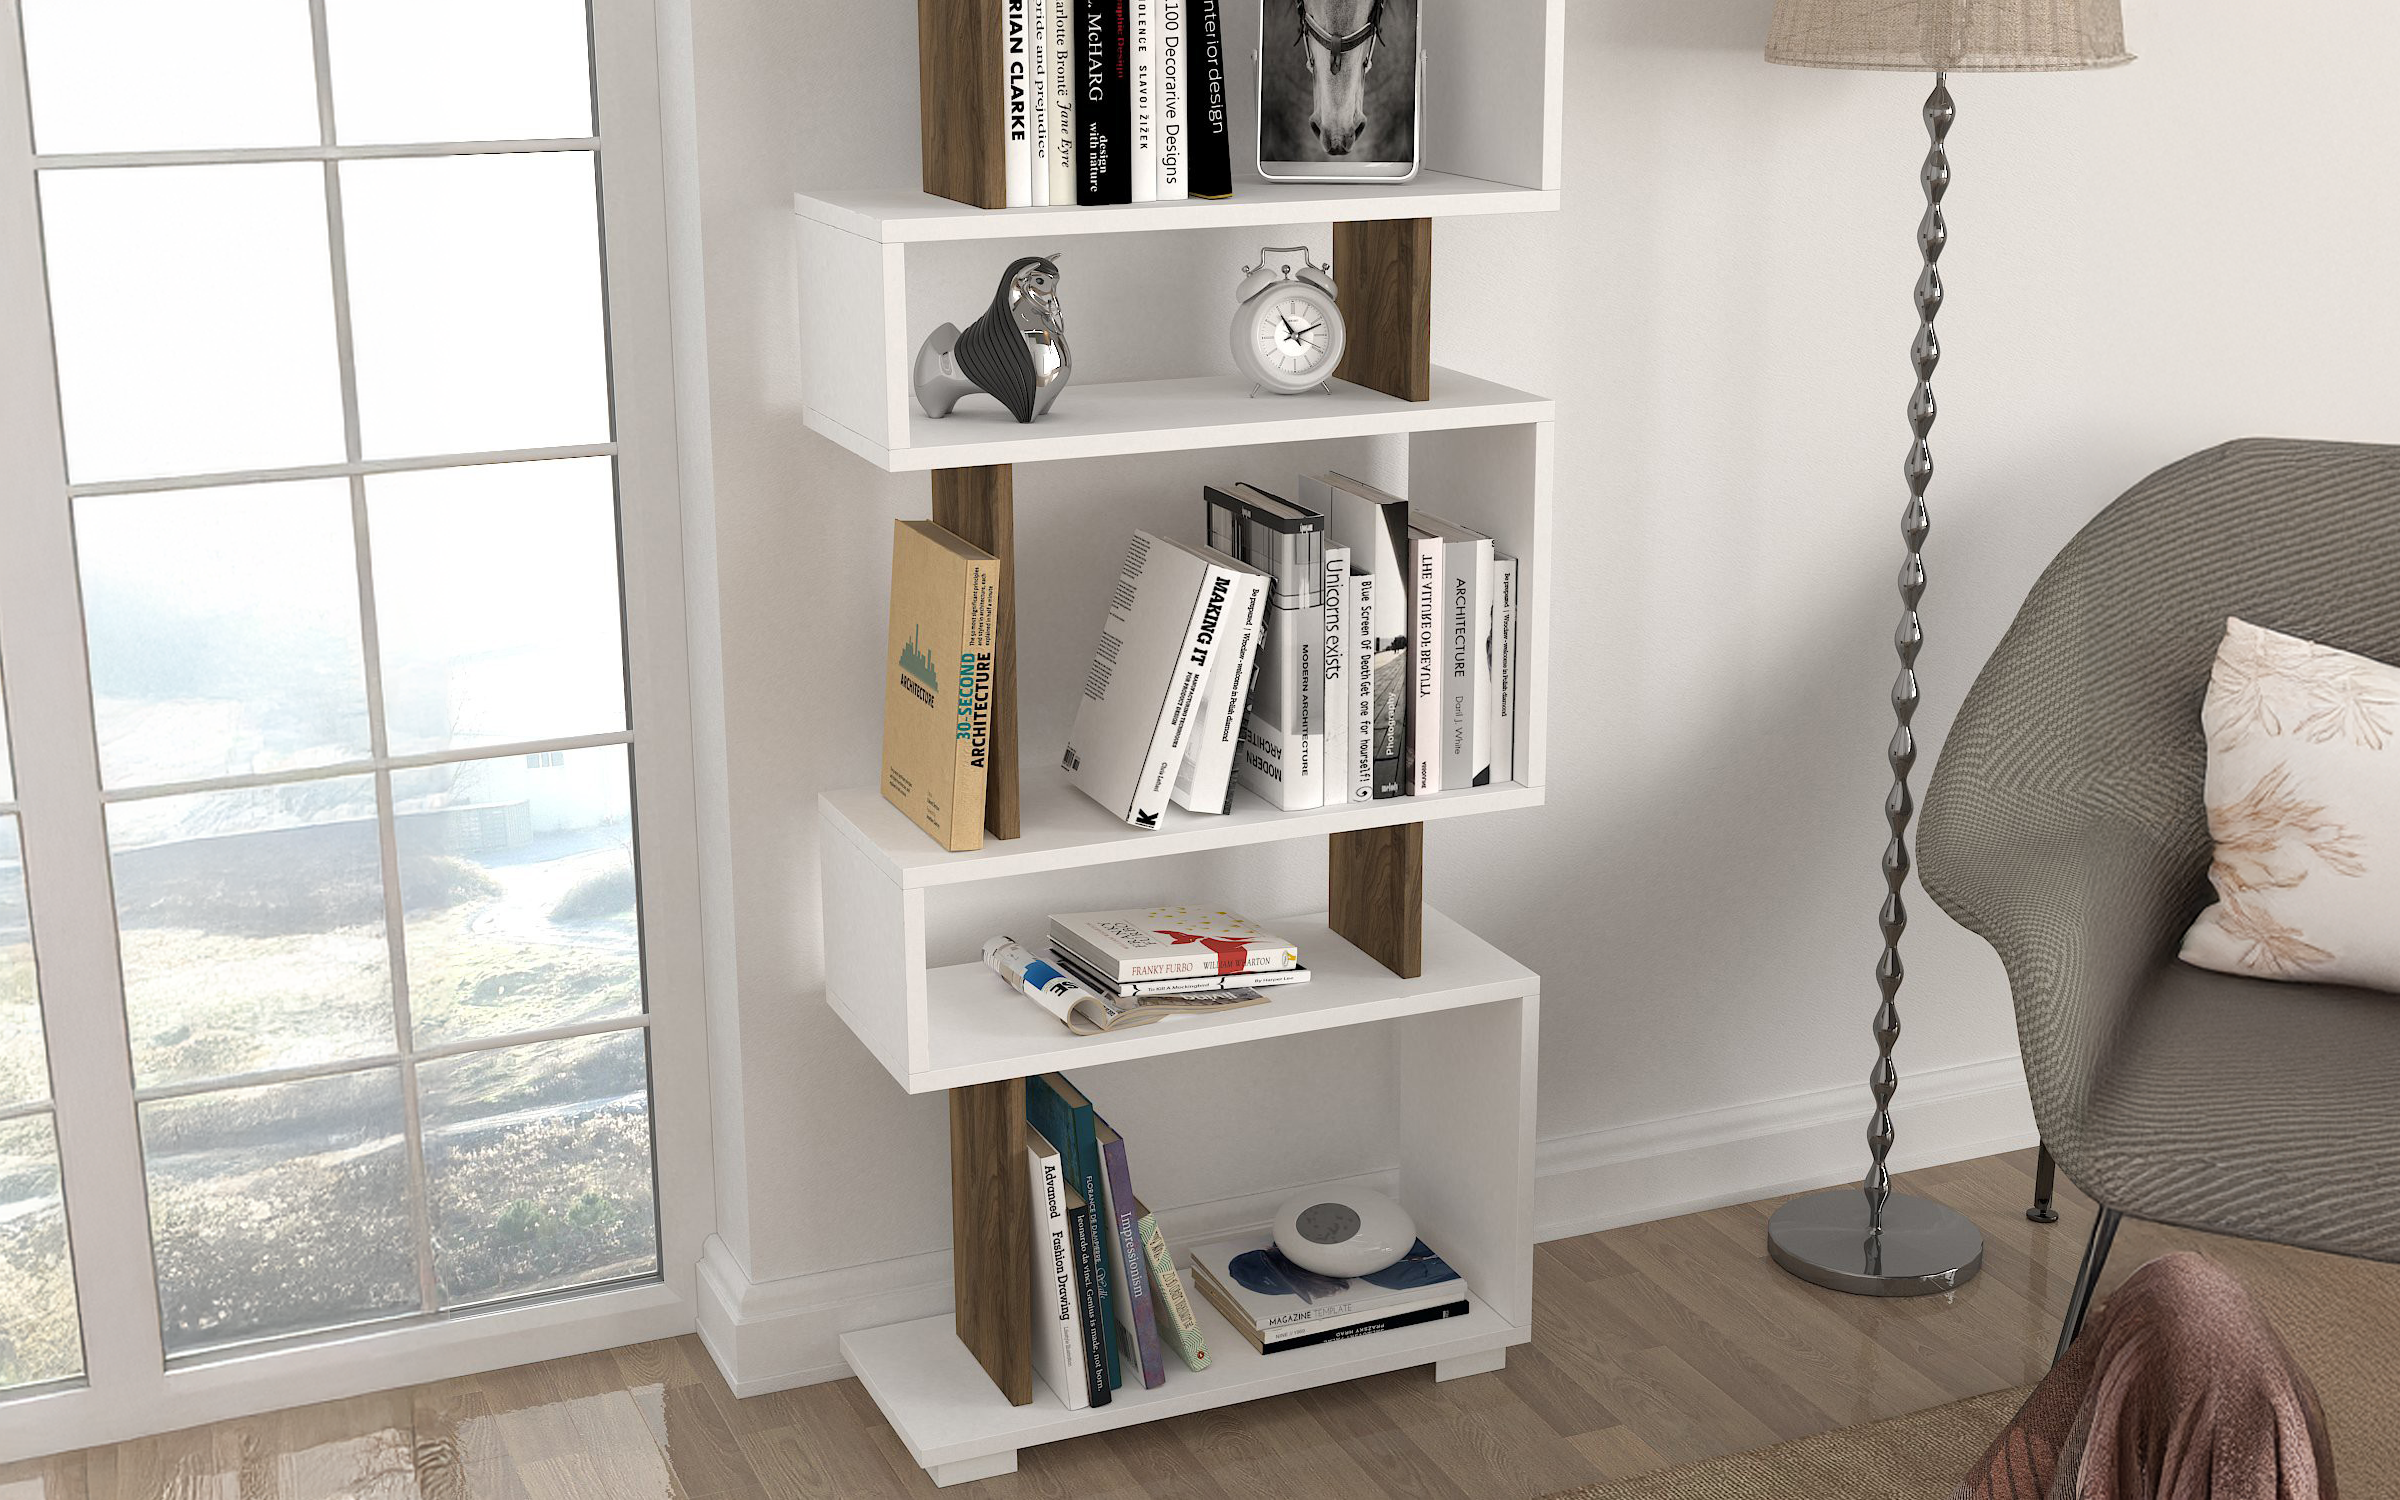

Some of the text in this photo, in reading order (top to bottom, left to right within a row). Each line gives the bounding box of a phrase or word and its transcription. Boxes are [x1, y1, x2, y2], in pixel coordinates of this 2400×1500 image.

[1036, 45, 1046, 75] and
[1087, 14, 1104, 102] McHARG
[1010, 61, 1025, 141] CLARKE
[1056, 0, 1073, 169] arlotte Brontë Jane Eyre
[1139, 65, 1148, 109] SLAVOJ
[1162, 0, 1180, 184] 100 Decorarive Designs
[1208, 69, 1224, 134] design
[1035, 80, 1047, 159] prejudice
[1140, 114, 1150, 150] ŽIŽEK
[1089, 122, 1100, 192] with nature
[1099, 135, 1108, 174] design
[1361, 581, 1372, 601] Blue
[1190, 576, 1231, 667] MAKING IT
[1326, 559, 1344, 680] Unicorns exists
[1361, 605, 1372, 636] Screen
[1454, 578, 1467, 678] ARCHITECTURE
[1360, 639, 1372, 650] Of
[1360, 654, 1371, 680] Death
[900, 673, 935, 709] ARCHITECTURE
[956, 653, 975, 740] 30-SECOND
[1360, 681, 1371, 697] Get
[970, 652, 991, 768] ARCHITECTURE
[1360, 701, 1369, 716] one
[1386, 692, 1397, 756] Photography
[1246, 730, 1282, 761] ARCHITE
[1360, 720, 1371, 735] for
[1454, 727, 1464, 755] White
[1246, 750, 1282, 783] MODERN
[1132, 957, 1271, 976] FRANKY FURBO WILLIAM WHARTON
[1086, 1175, 1096, 1213] FLORANCE
[1077, 1214, 1088, 1252] leonardo
[1090, 1214, 1097, 1223] DE
[1044, 1165, 1071, 1321] Advanced Fashion Drawing
[1082, 1253, 1090, 1264] da
[1120, 1211, 1143, 1298] Impressionism
[1086, 1289, 1096, 1319] Genius
[1269, 1303, 1352, 1326] MAGAZINE TEMPLATE
[1089, 1319, 1096, 1327] is
[1091, 1327, 1100, 1353] made,
[1093, 1354, 1102, 1368] not
